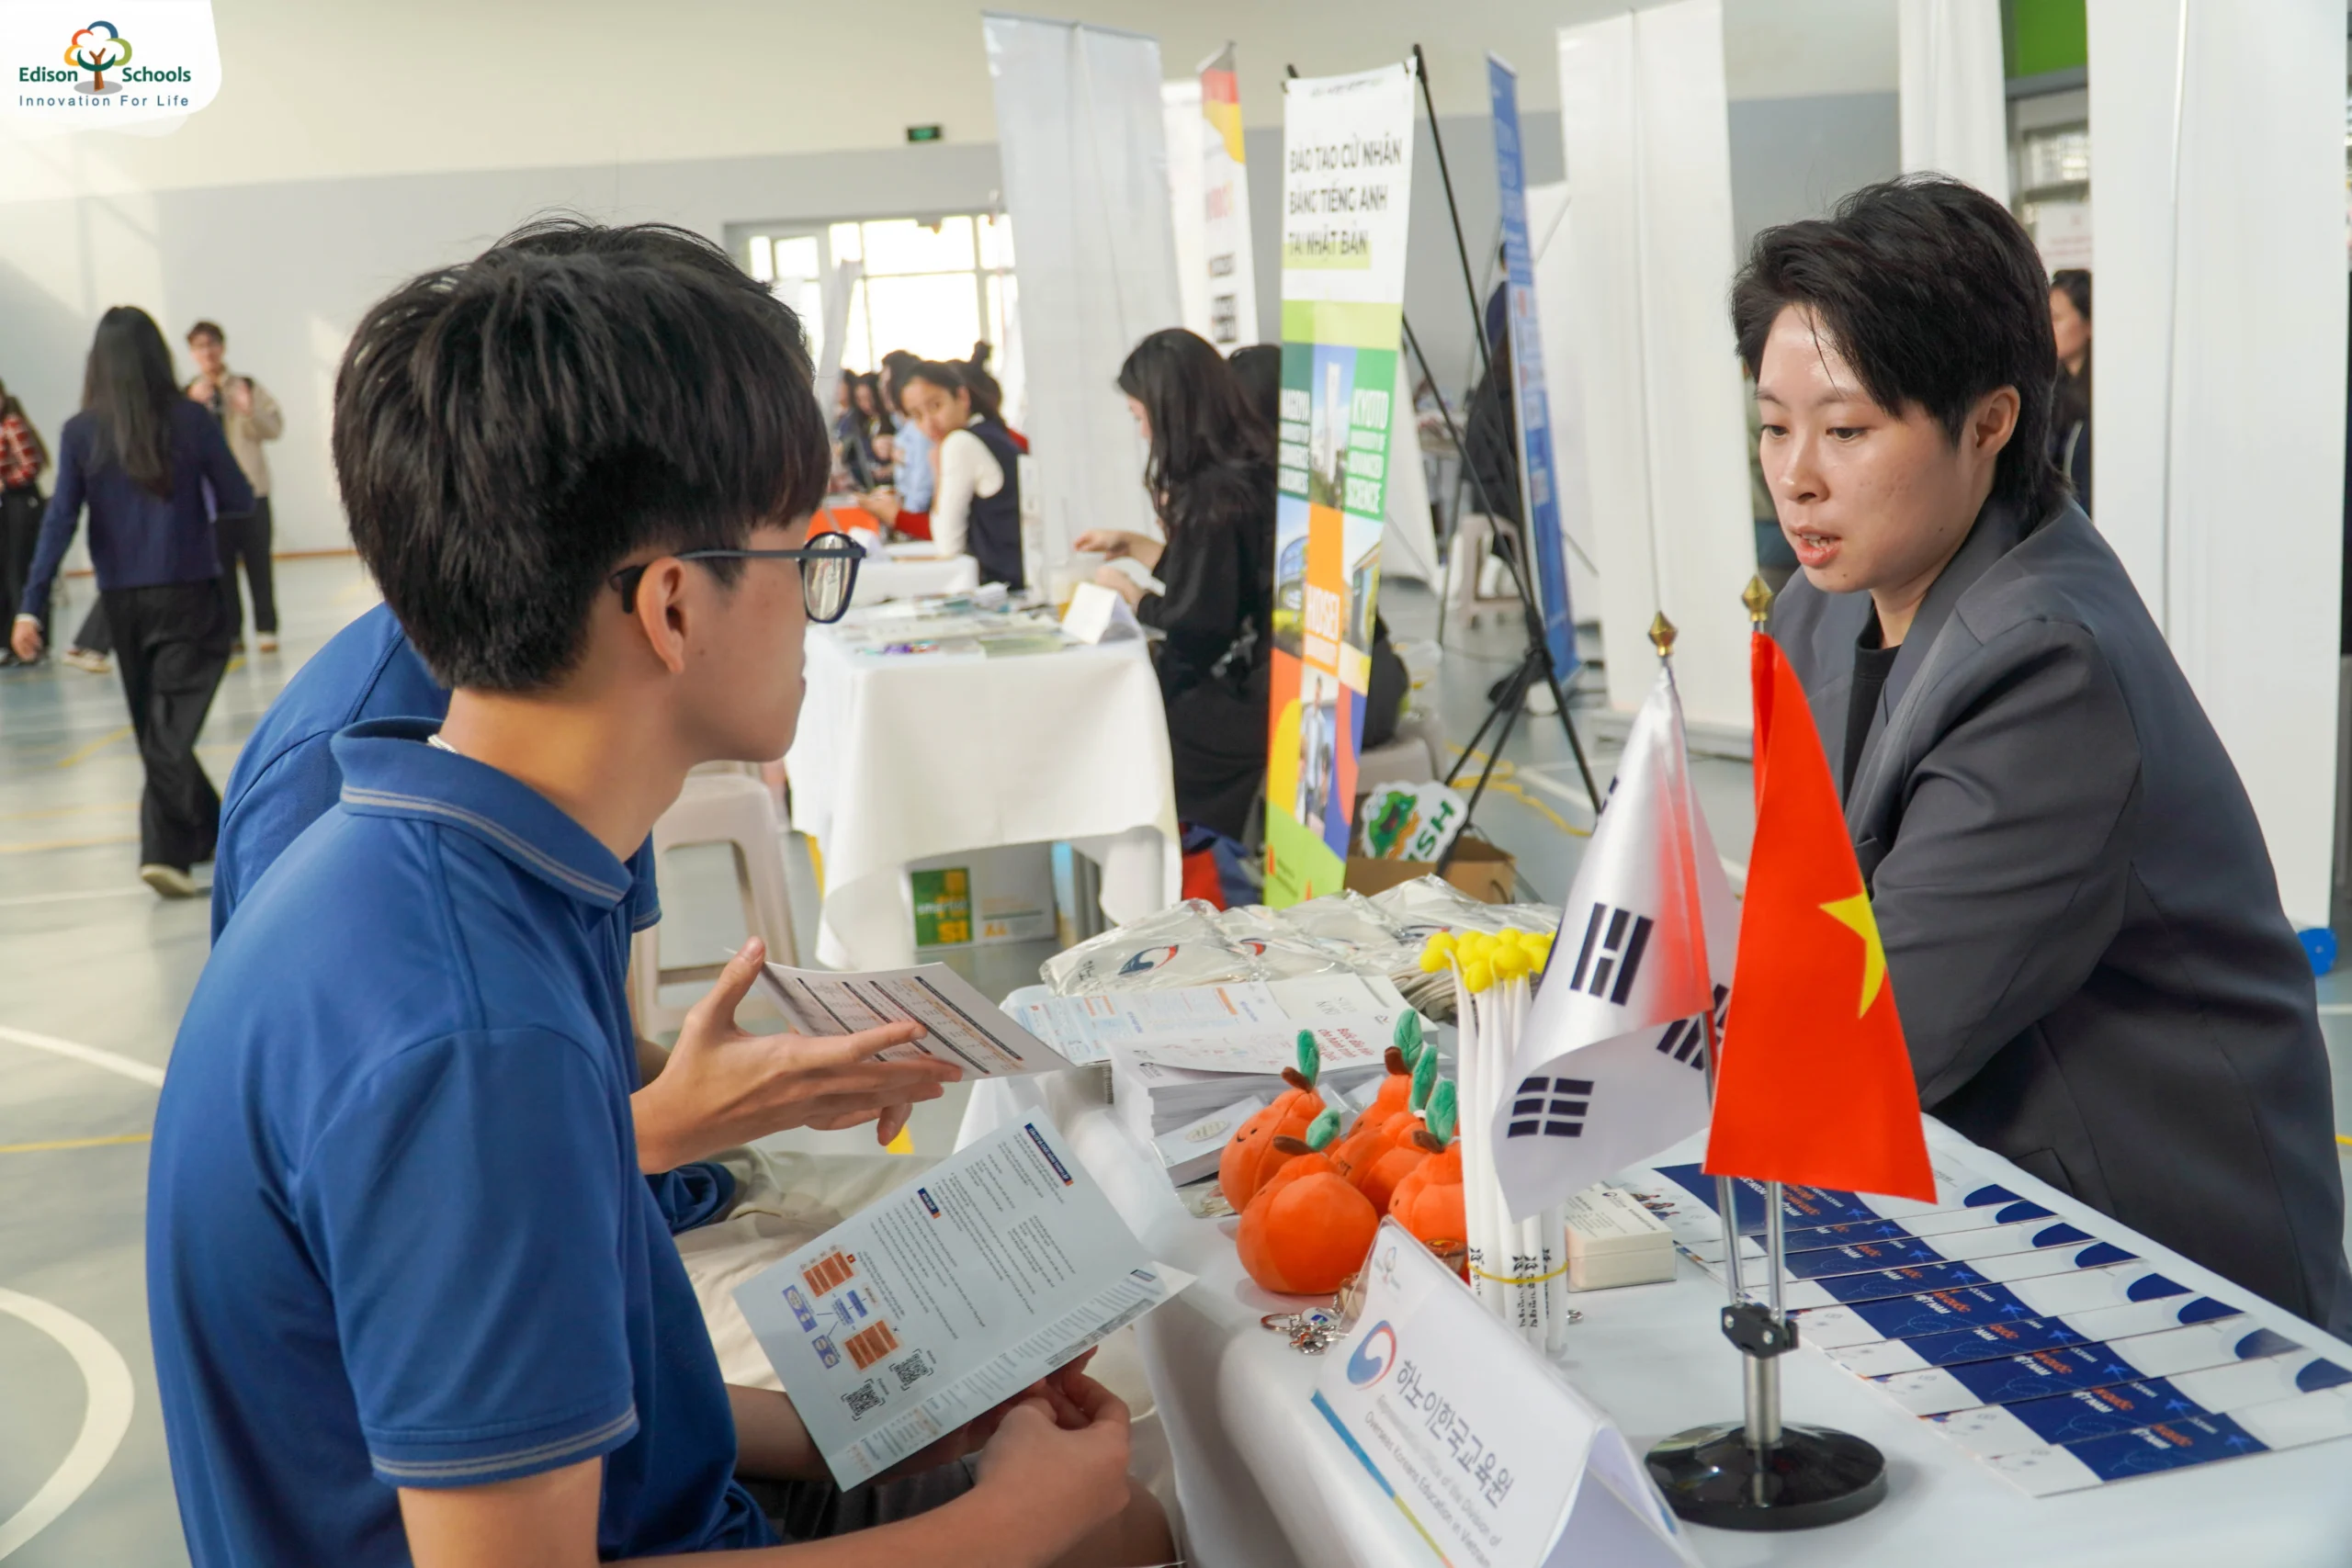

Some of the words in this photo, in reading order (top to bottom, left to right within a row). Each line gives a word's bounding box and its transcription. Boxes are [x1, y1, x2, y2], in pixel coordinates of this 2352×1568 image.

[1360, 185, 1388, 211] ANH
[1351, 388, 1390, 430] KYOTO
[1306, 585, 1341, 641] HOSEI
[1926, 1303, 1951, 1314] NAM
[1396, 1360, 1514, 1508] 하노이한국교육원
[1364, 1410, 1394, 1452] Overseas
[1393, 1445, 1420, 1483] Koreans
[1418, 1476, 1453, 1525] Education
